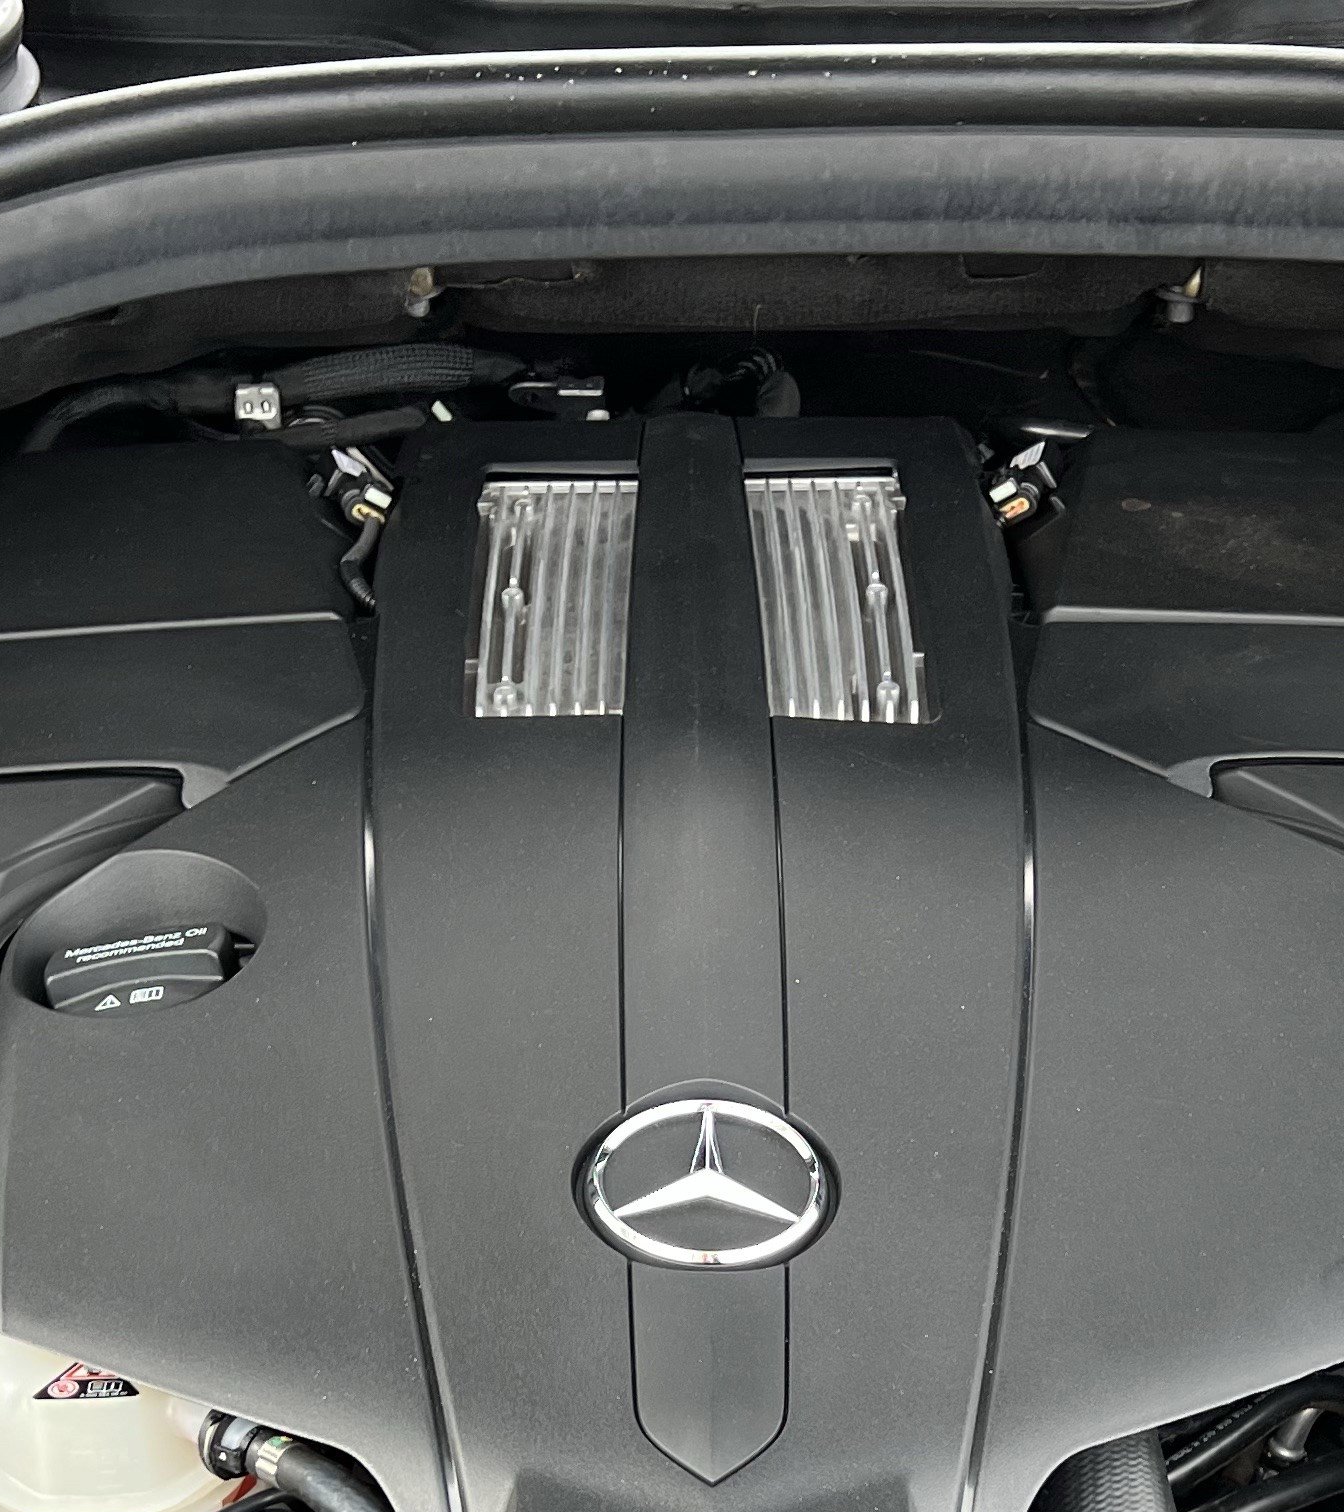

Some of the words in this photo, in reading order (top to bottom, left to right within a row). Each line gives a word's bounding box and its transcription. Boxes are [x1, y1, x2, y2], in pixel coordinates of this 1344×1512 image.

[64, 931, 182, 959] Mercedes-Benz
[184, 926, 208, 938] Oil
[75, 937, 185, 964] recommended
